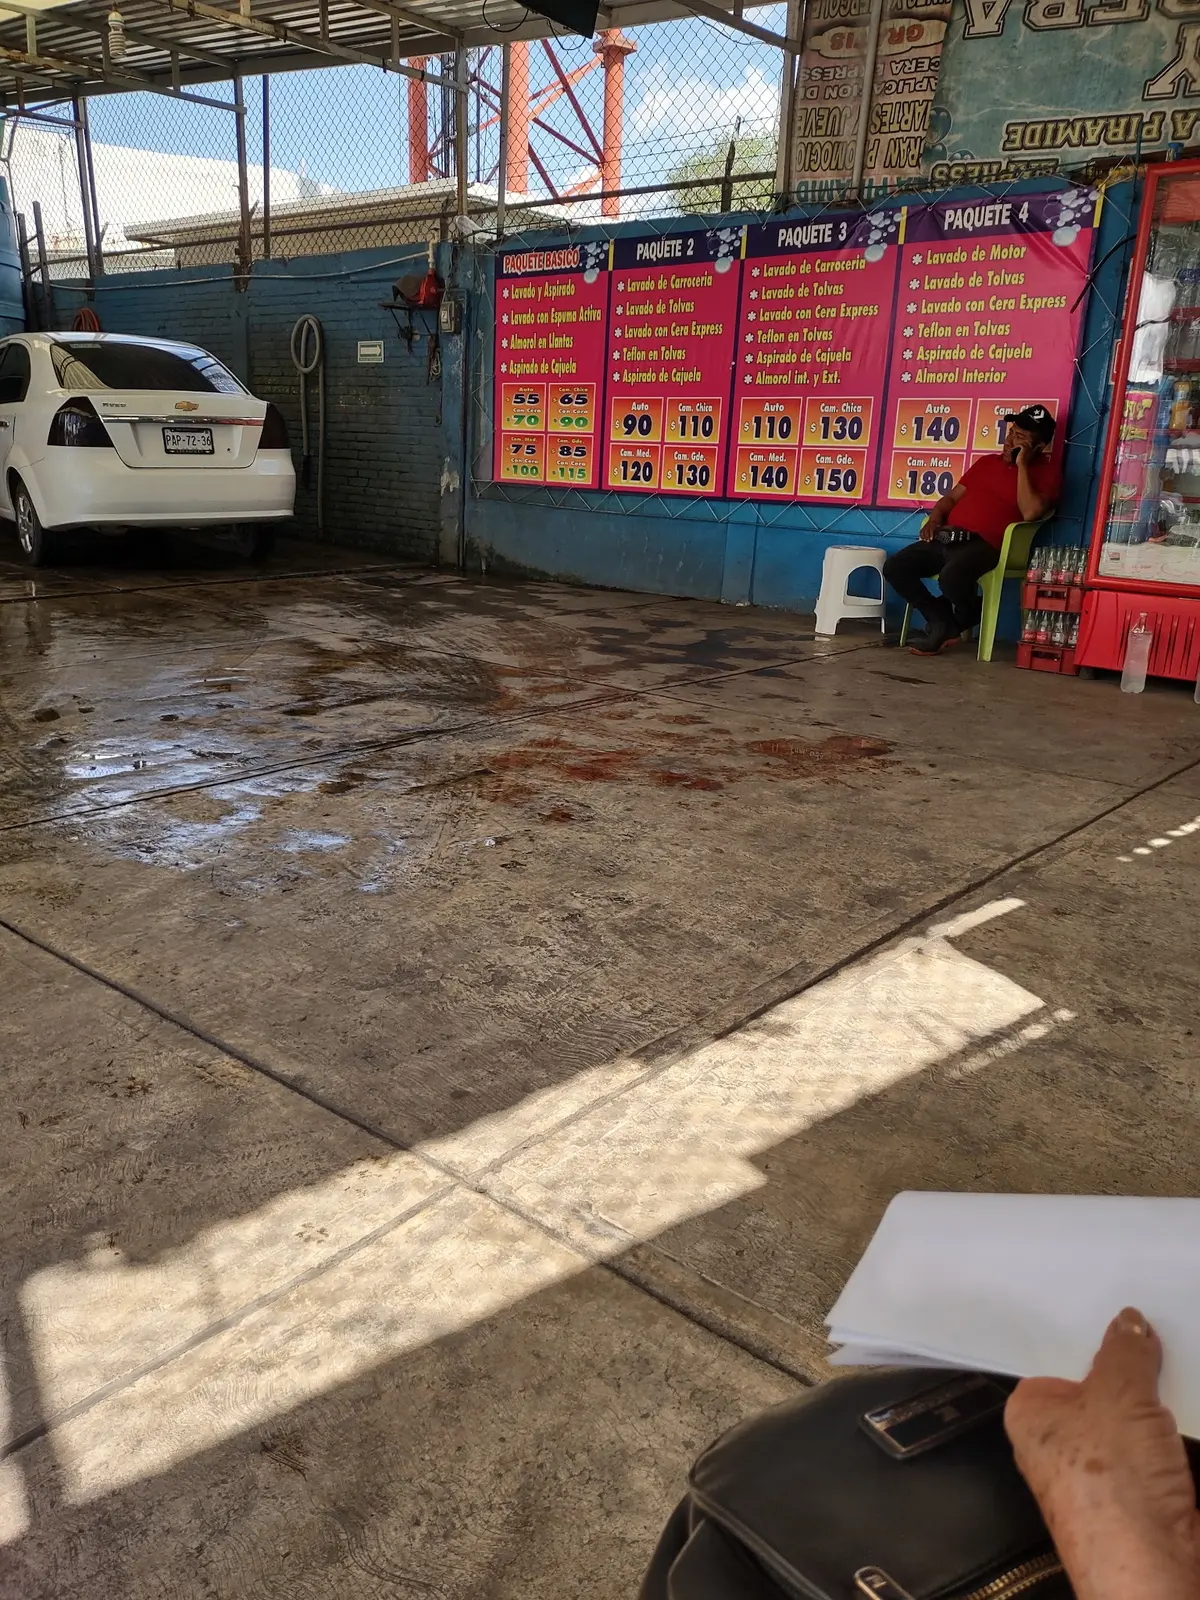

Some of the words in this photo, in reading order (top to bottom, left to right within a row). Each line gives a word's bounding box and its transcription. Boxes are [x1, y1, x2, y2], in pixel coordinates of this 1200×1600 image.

[801, 63, 884, 81] EPRESS
[824, 76, 938, 98] APLICAION
[1003, 111, 1166, 151] PIRAMIDE
[884, 136, 926, 168] RAN
[944, 203, 1012, 231] PAQUETE
[1019, 201, 1029, 223] 4
[778, 223, 833, 248] PAQUETE
[838, 222, 847, 241] 3
[636, 239, 682, 261] PAQUETE
[687, 238, 695, 255] 2
[927, 247, 967, 265] Lavado
[971, 245, 985, 261] de
[990, 244, 1026, 260] Motor
[503, 252, 544, 275] PAQUETE
[544, 249, 580, 270] BASICO
[763, 261, 796, 277] Lavado
[800, 259, 811, 274] de
[627, 276, 655, 292] Lavado
[658, 274, 667, 289] de
[924, 273, 964, 290] Lavado
[969, 271, 982, 287] de
[988, 269, 1024, 286] Tolvas
[511, 282, 535, 299] Lavado
[538, 286, 542, 302] y
[544, 279, 575, 301] Aspirado
[761, 284, 794, 300] Lavado
[798, 283, 809, 297] de
[813, 281, 843, 296] Tolvas
[626, 300, 653, 316] Lavado
[656, 300, 666, 314] de
[669, 298, 694, 314] Tolvas
[759, 306, 792, 322] Lavado
[795, 308, 811, 320] con
[815, 305, 836, 318] Cera
[840, 303, 878, 320] Express
[921, 298, 961, 314] Lavado
[966, 299, 984, 311] con
[989, 296, 1015, 310] Cera
[1020, 293, 1066, 313] Express
[511, 309, 534, 325] Lavado
[537, 311, 548, 322] con
[551, 309, 576, 326] Espuma
[579, 305, 601, 321] Activa
[625, 323, 652, 338] Lavado
[655, 326, 667, 337] con
[671, 322, 688, 336] Cera
[692, 322, 723, 340] Express
[757, 328, 784, 343] Teflon
[788, 332, 798, 342] en
[803, 327, 832, 341] Tolvas
[918, 322, 951, 338] Teflon
[956, 326, 969, 336] en
[974, 320, 1010, 336] Tolvas
[539, 338, 547, 348] en
[549, 333, 573, 348] Llantas
[623, 347, 646, 361] Teflon
[649, 350, 658, 360] en
[660, 346, 686, 360] Tolvas
[756, 349, 796, 367] Aspirado
[800, 348, 811, 362] de
[815, 347, 851, 365] Cajuela
[917, 344, 966, 364] Aspirado
[970, 343, 984, 359] de
[989, 342, 1032, 363] Cajuela
[510, 358, 539, 377] Aspirado
[541, 358, 548, 373] de
[552, 357, 576, 377] Cajuela
[915, 367, 959, 383] Almorol
[962, 366, 1006, 383] Interior
[623, 369, 656, 387] Aspirado
[659, 368, 669, 382] de
[671, 367, 701, 386] Cajuela
[756, 370, 791, 385] Almorol
[813, 373, 819, 387] y
[822, 370, 840, 384] Ext.
[631, 402, 649, 411] Auto
[678, 403, 693, 412] Cam.
[696, 403, 713, 412] Chica
[763, 403, 785, 412] Auto
[820, 403, 840, 413] Cam.
[841, 403, 861, 413] Chica
[925, 404, 951, 414] Auto
[166, 435, 211, 446] PAP-72-36
[620, 449, 634, 458] Cam.
[636, 449, 651, 458] Med.
[674, 452, 689, 461] Cam.
[691, 453, 705, 462] Gde.
[749, 452, 767, 462] Cam.
[769, 453, 786, 463] Med.
[816, 454, 833, 465] Cam.
[835, 454, 854, 466] Gde.
[907, 457, 927, 468] Cam.
[930, 457, 951, 468] Med.
